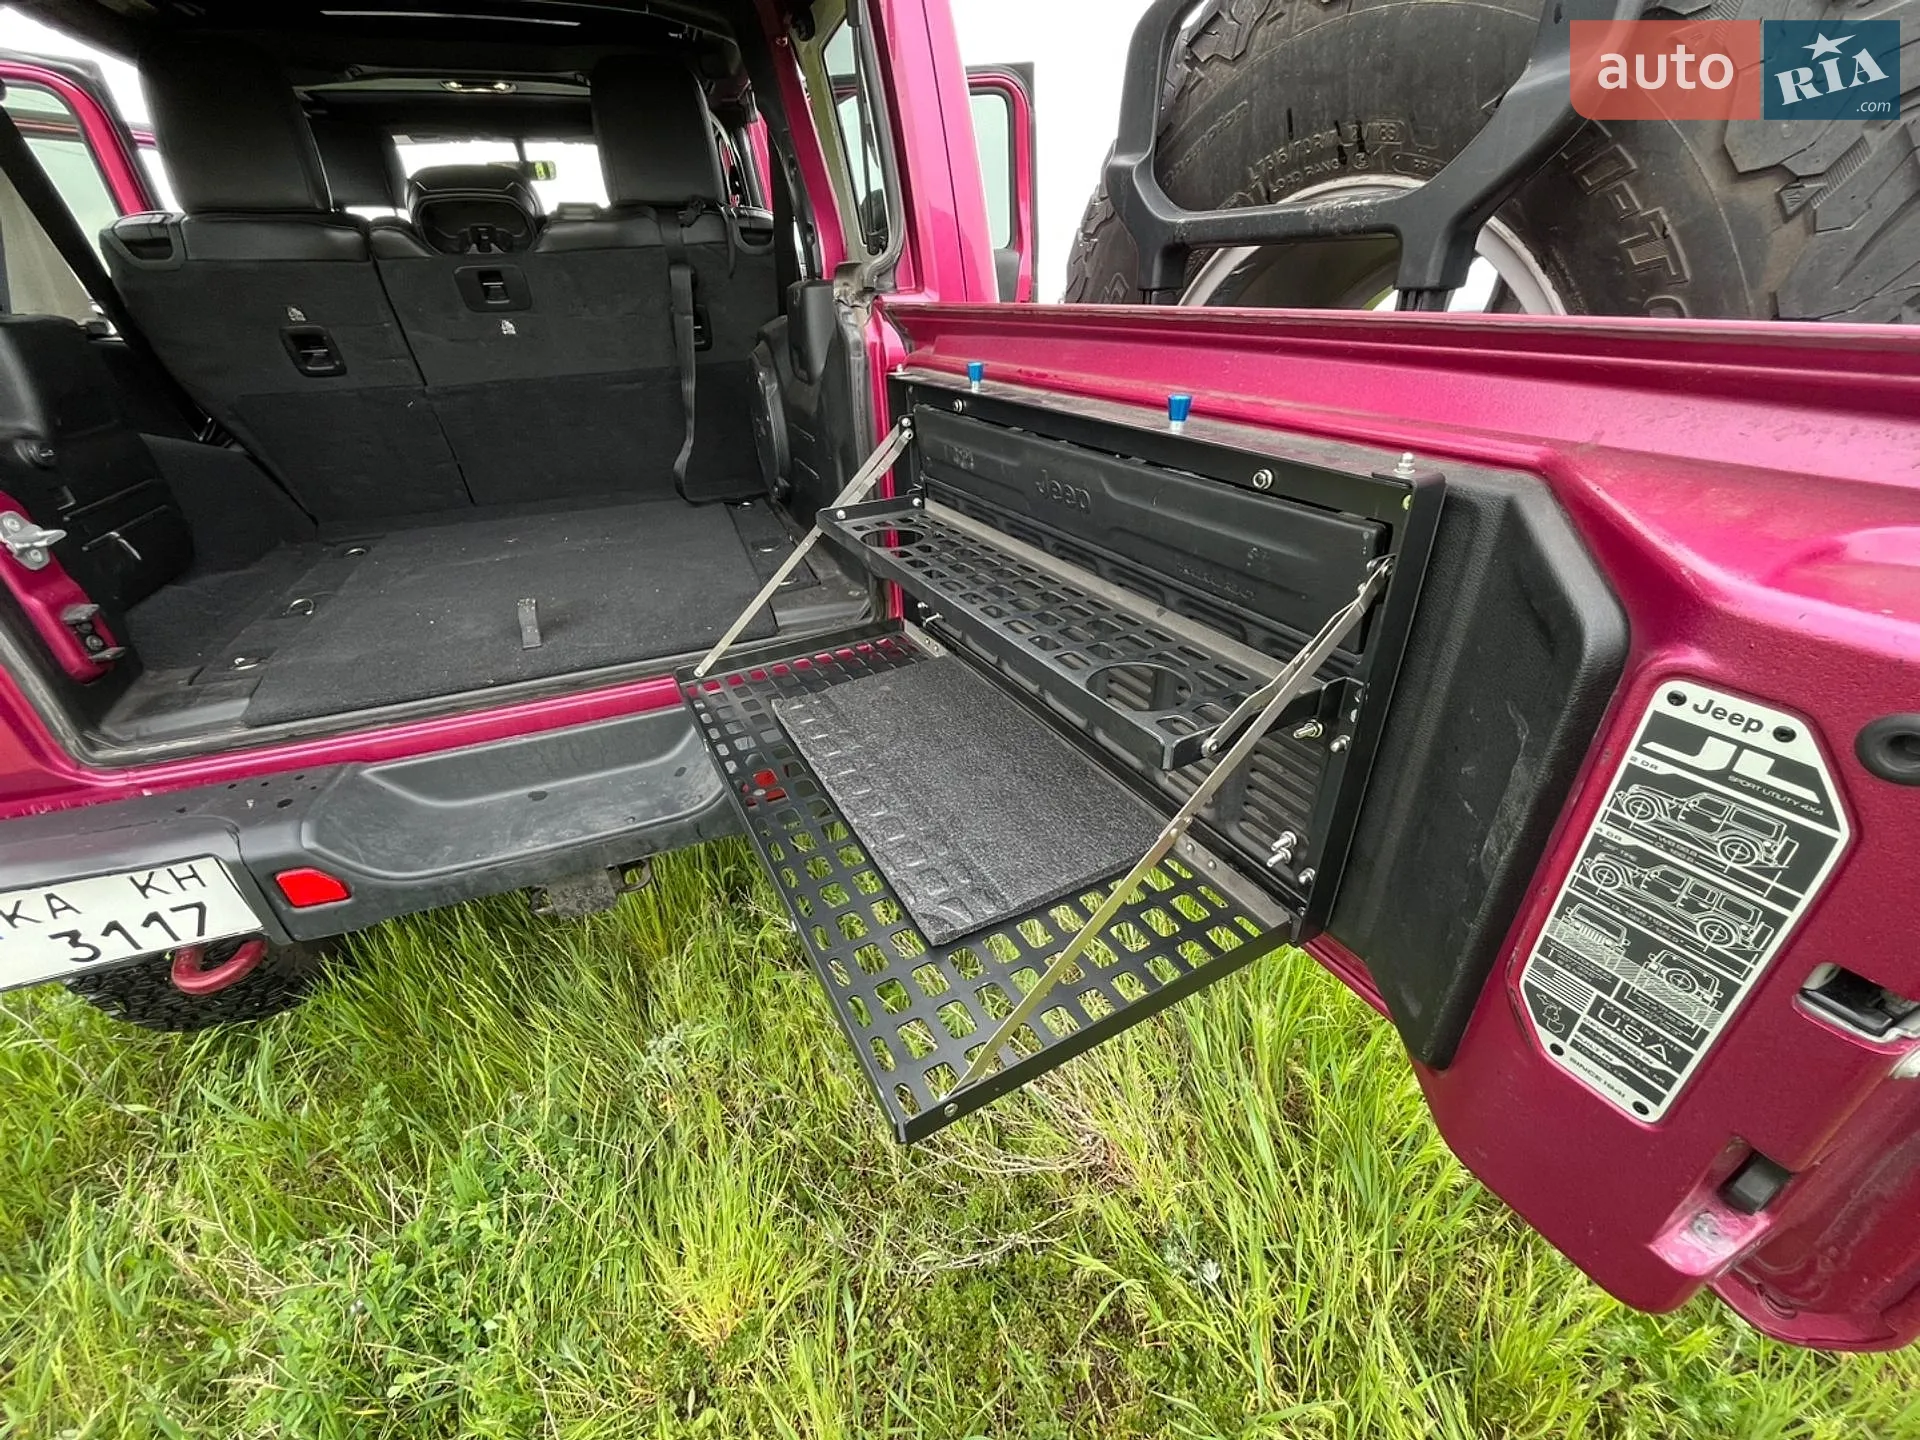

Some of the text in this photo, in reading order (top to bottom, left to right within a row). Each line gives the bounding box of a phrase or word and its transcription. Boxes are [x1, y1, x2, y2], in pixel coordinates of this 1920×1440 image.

[1034, 468, 1091, 516] Jeep
[1692, 699, 1764, 734] Jeep
[1642, 736, 1821, 804] JL
[1727, 774, 1762, 793] SPORT
[1763, 786, 1800, 807] UTILITY
[0, 863, 207, 929] KA KH
[48, 901, 207, 963] 3117
[1582, 1016, 1642, 1057] DEVELOPED
[1598, 1007, 1672, 1065] U.S.A.
[1603, 1002, 1638, 1026] MADE
[1640, 1025, 1654, 1036] IN
[1658, 1036, 1681, 1053] THE
[1569, 1056, 1603, 1082] SINCE
